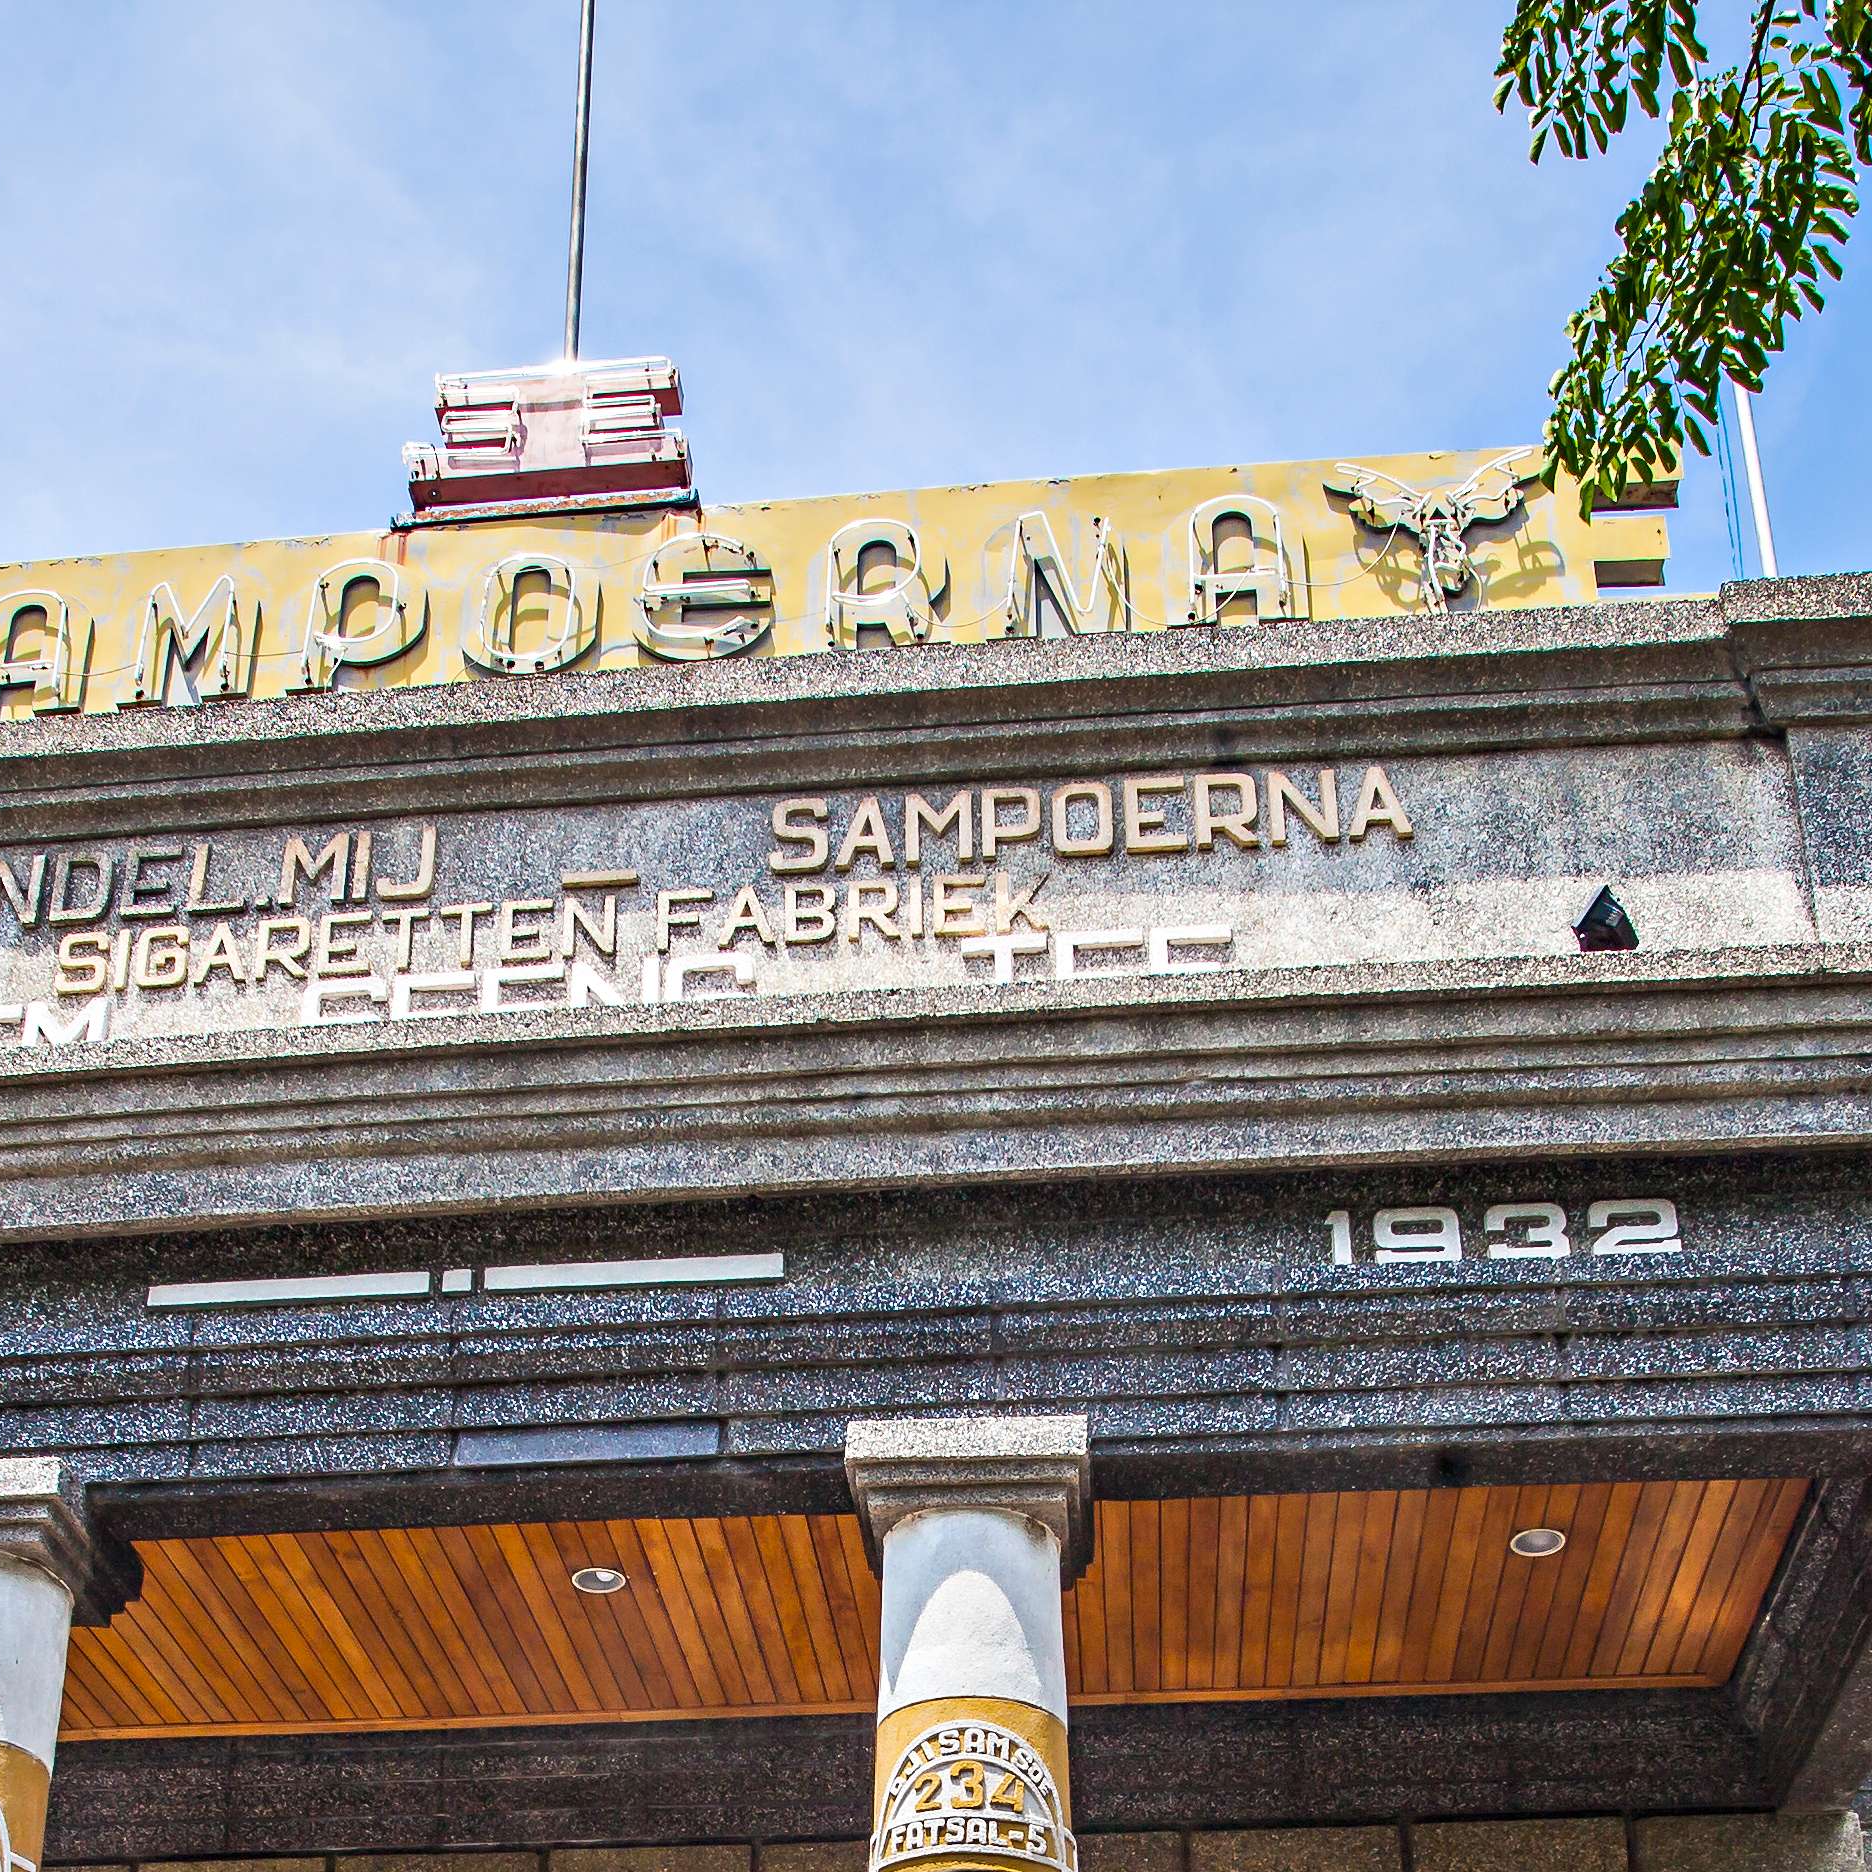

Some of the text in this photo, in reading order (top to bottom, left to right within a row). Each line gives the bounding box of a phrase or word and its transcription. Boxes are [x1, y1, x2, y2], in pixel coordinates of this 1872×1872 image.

[770, 767, 1413, 875] SAMPOERNA
[54, 870, 1049, 996] SIGARETTEN FABRIEK
[1324, 1198, 1682, 1265] 1932
[914, 1760, 1025, 1814] 234
[890, 1817, 1047, 1855] FATSAL-5
